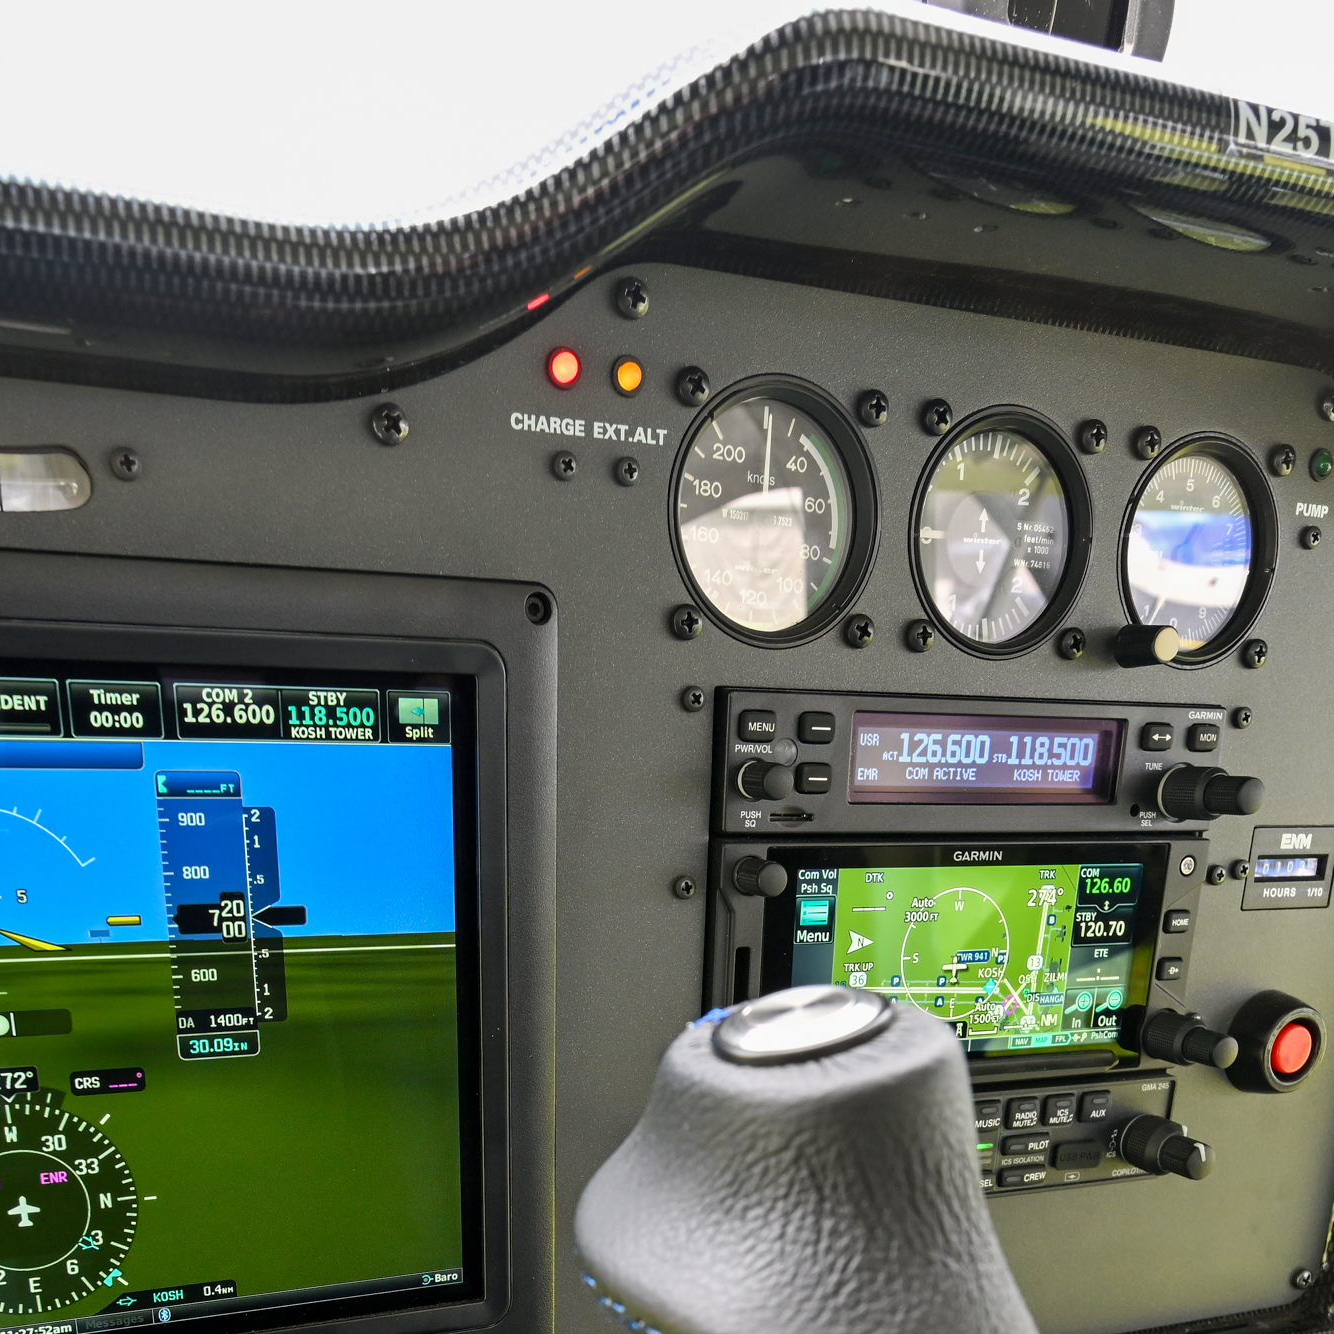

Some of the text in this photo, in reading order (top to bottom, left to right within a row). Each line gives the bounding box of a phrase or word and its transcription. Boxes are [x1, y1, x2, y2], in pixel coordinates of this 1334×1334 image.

[510, 412, 586, 437] CHARGE
[593, 421, 668, 446] EXT.ALT
[713, 443, 746, 463] 200
[786, 456, 808, 473] 40
[692, 479, 722, 498] 180
[804, 498, 826, 514] 60
[1295, 502, 1329, 519] PUMP
[689, 526, 719, 543] 160
[800, 545, 820, 560] 80
[704, 571, 733, 587] 140
[776, 577, 804, 594] 100
[739, 589, 767, 606] 120
[89, 689, 140, 706] Timer
[201, 688, 238, 703] COM
[309, 691, 347, 707] STBY
[89, 712, 144, 728] 00:00
[183, 703, 275, 725] 126.600
[287, 706, 374, 726] 118.500
[1188, 711, 1223, 721] GARMIN
[291, 727, 373, 740] KOSH TOWER
[405, 727, 434, 740] Split
[748, 722, 776, 733] MENU
[860, 733, 880, 747] USR
[735, 744, 773, 754] PWR/VOL
[898, 732, 991, 764] 126.600
[1007, 735, 1095, 767] 118.500
[857, 767, 878, 781] EMR
[905, 767, 977, 781] COM ACTIVE
[1013, 768, 1080, 783] KOSH TOWER
[178, 813, 205, 826] 900
[740, 810, 762, 820] PUSH
[1280, 833, 1313, 849] ENM
[953, 850, 1003, 862] GARMIN
[182, 866, 209, 879] 800
[1085, 877, 1131, 894] 126.60
[1263, 887, 1296, 898] HOURS
[796, 929, 830, 944] Menu
[1079, 921, 1125, 937] 120.70
[191, 968, 217, 982] 600
[1098, 1015, 1117, 1027] Out
[74, 1077, 100, 1090] CRS
[1015, 1111, 1037, 1120] RADIO
[1090, 1109, 1106, 1118] AUX
[975, 1118, 1001, 1128] MUSIC
[41, 1134, 67, 1152] 30
[1028, 1140, 1049, 1151] PILOT
[74, 1158, 99, 1175] 33
[1013, 1155, 1044, 1164] ISOLATION
[40, 1171, 68, 1184] ENR
[1023, 1171, 1046, 1182] CREW
[434, 1270, 459, 1283] Baro
[153, 1288, 184, 1303] KOSH
